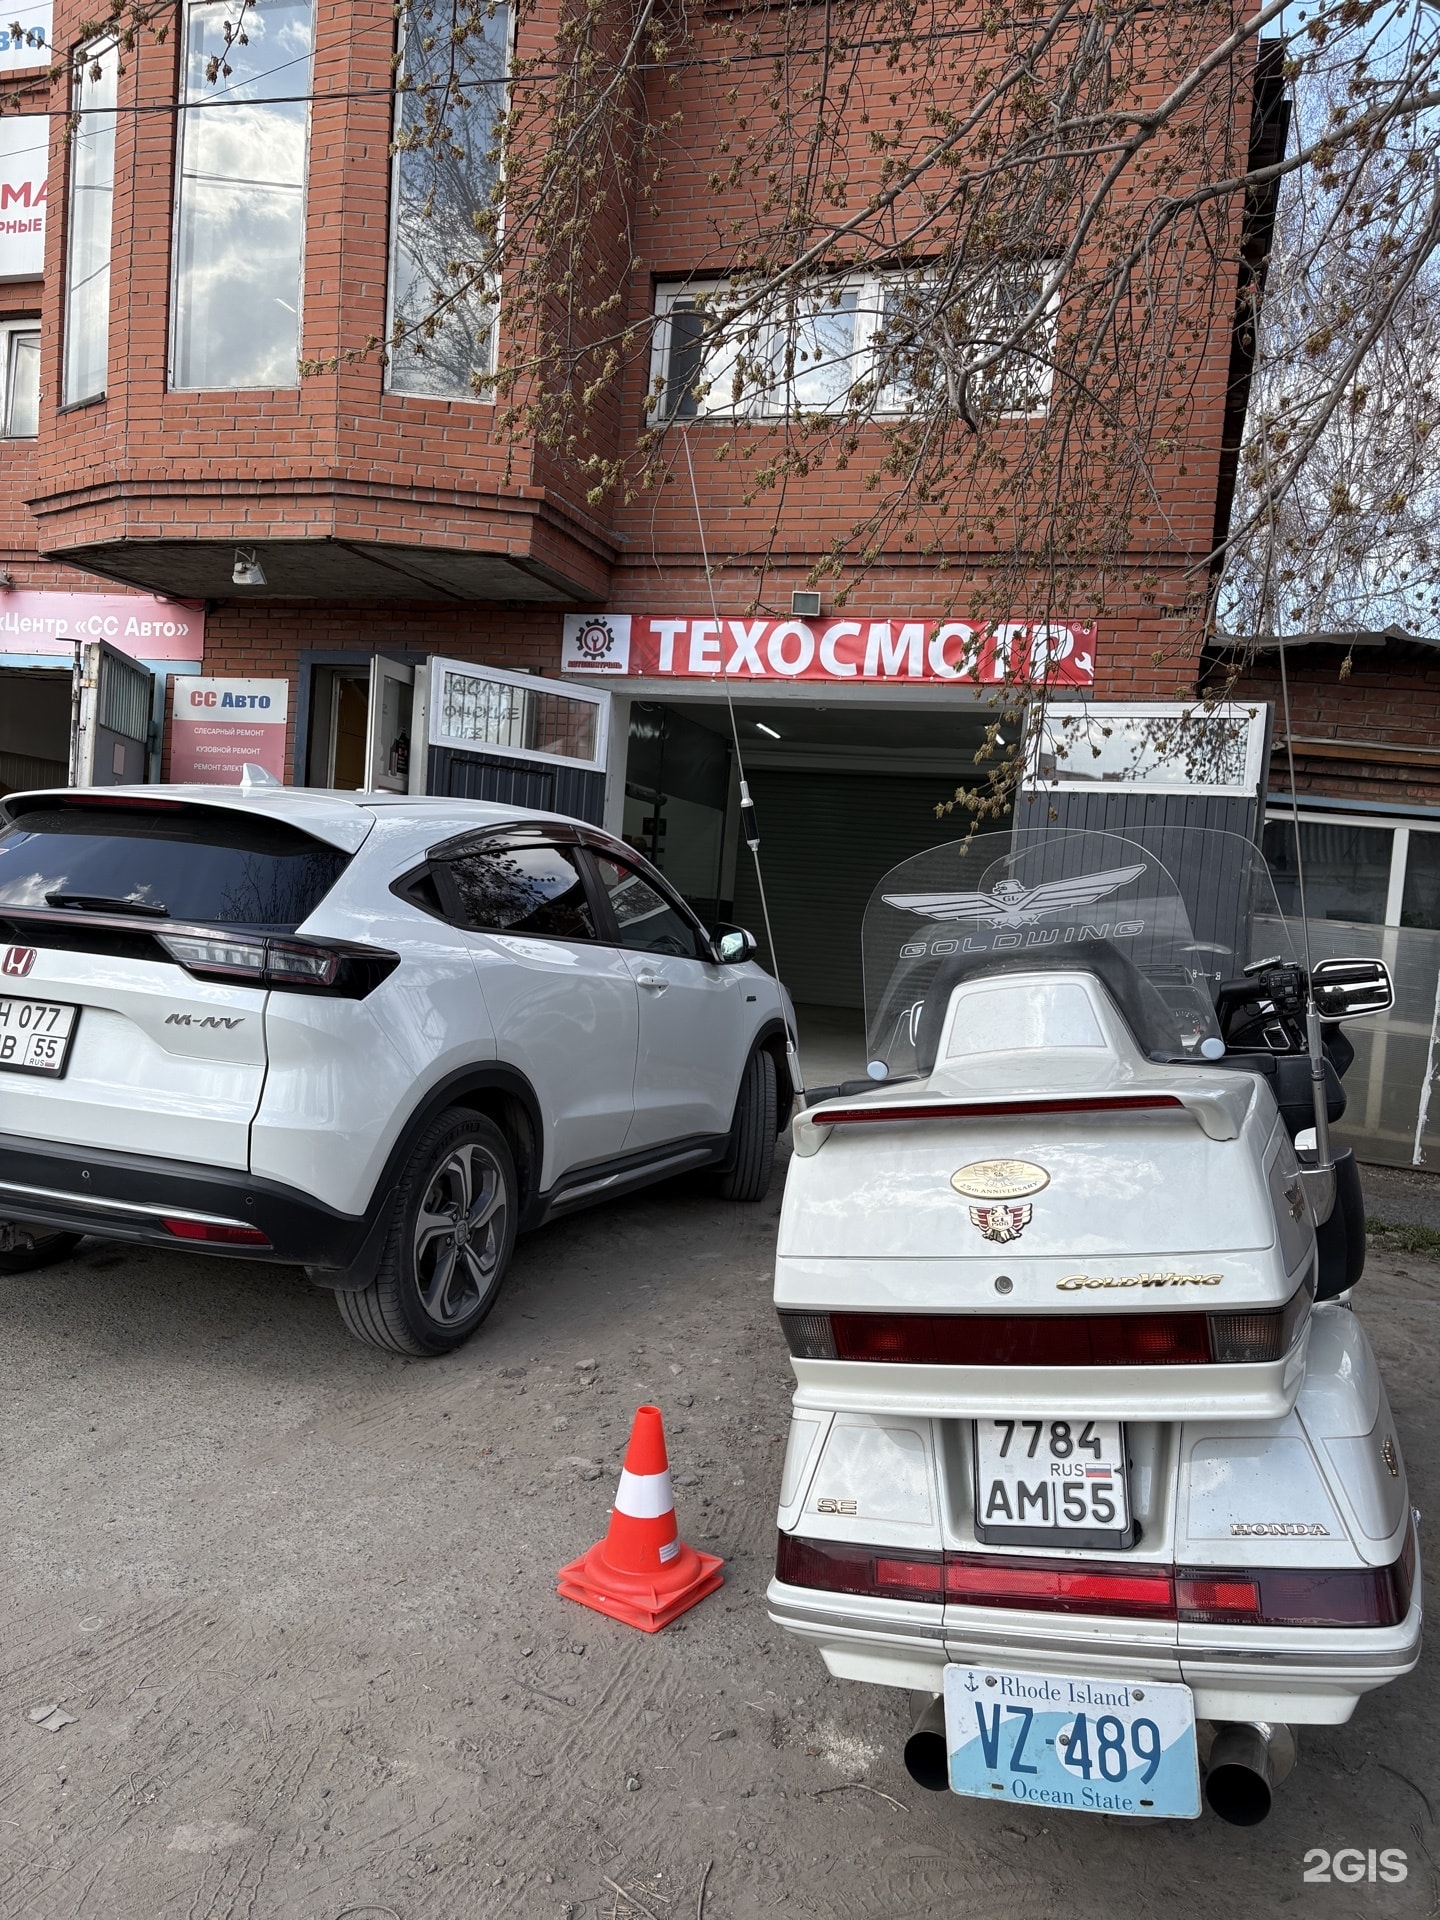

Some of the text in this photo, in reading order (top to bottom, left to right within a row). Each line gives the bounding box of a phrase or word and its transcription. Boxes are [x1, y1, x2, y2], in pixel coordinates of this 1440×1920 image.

[649, 619, 1075, 680] ТЕХОСМОТР
[190, 690, 218, 708] СС
[193, 726, 235, 736] СЛЕСАРНЫЙ
[196, 745, 261, 755] КУЗОВНОЙ РЕМОНТ
[193, 763, 221, 771] РЕМОНТ
[899, 920, 1145, 958] GOLDWING
[19, 1004, 61, 1032] 077
[34, 1038, 58, 1058] 55
[29, 1058, 45, 1066] RUS
[994, 1420, 1101, 1460] 7784
[1051, 1463, 1084, 1477] RUS
[817, 1497, 857, 1515] SE
[986, 1480, 1115, 1523] АМ 55
[1230, 1523, 1330, 1536] HONDA
[999, 1675, 1131, 1708] Rhode Island
[1012, 1778, 1133, 1811] Ocean State
